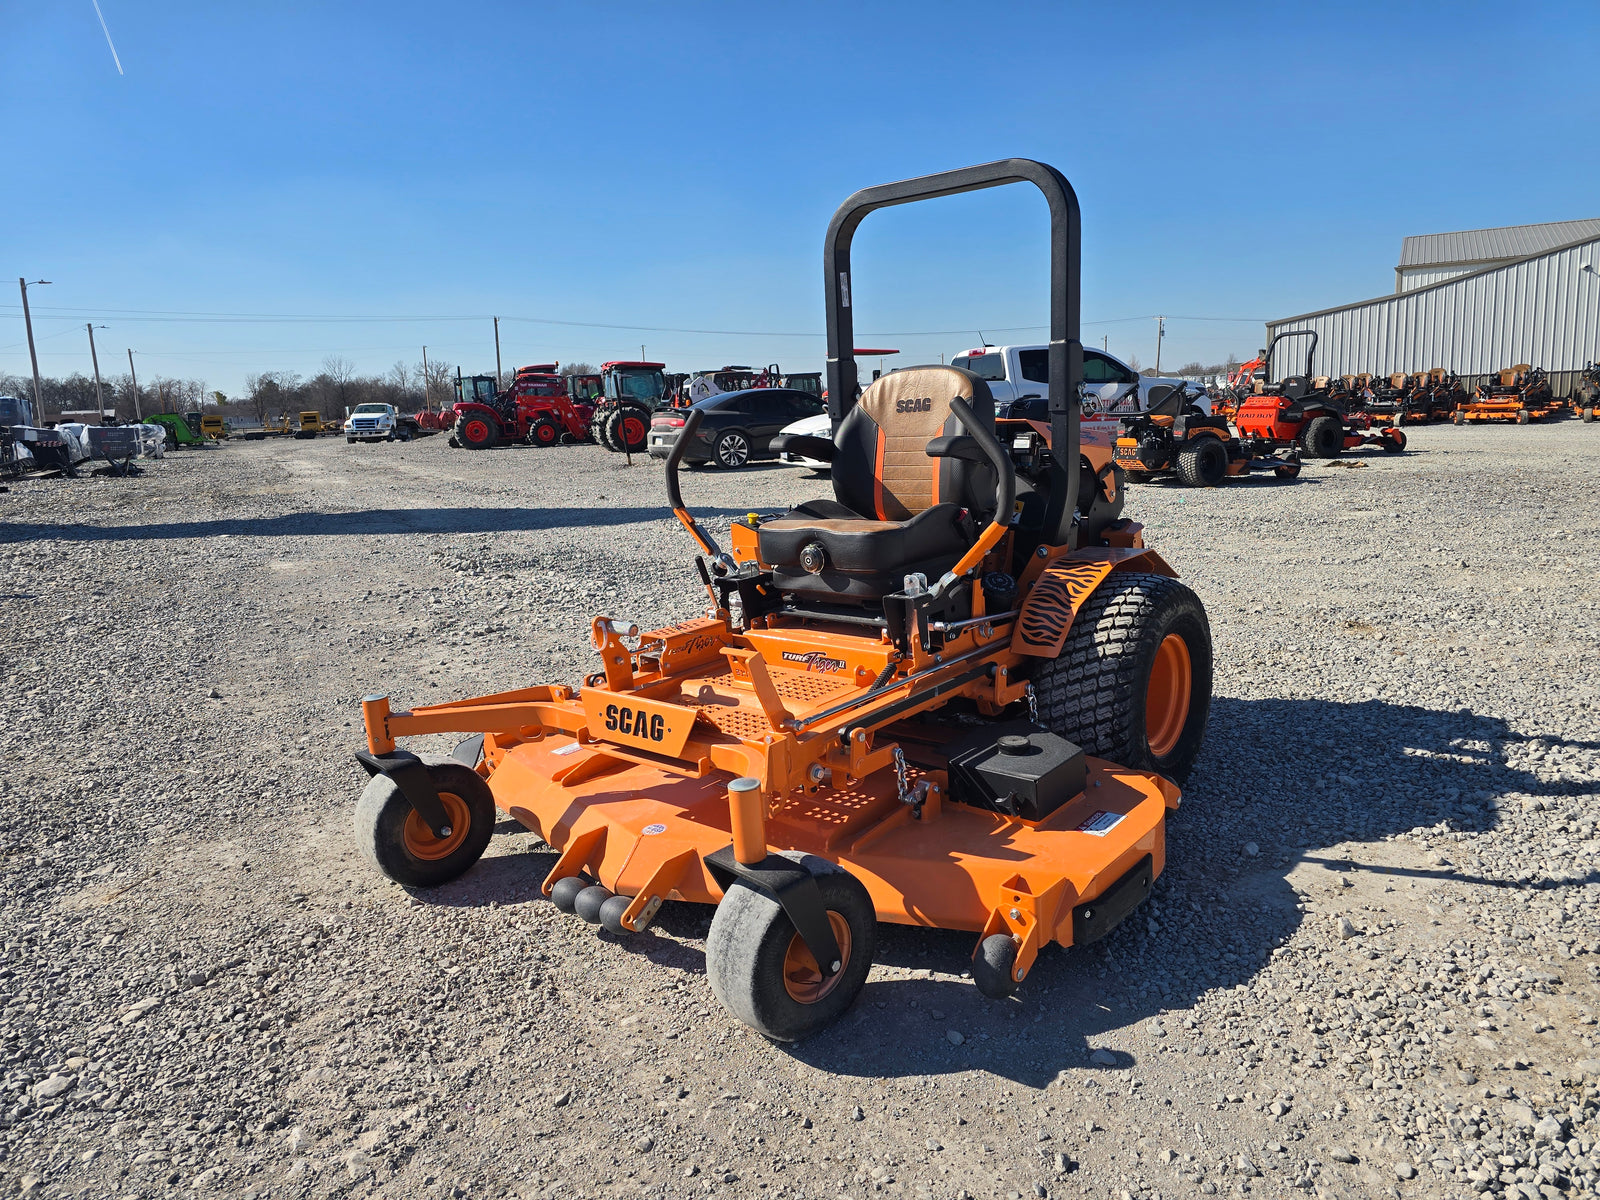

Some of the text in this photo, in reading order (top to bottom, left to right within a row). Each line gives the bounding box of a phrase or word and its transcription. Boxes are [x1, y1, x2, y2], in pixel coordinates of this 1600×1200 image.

[896, 397, 931, 413] SCAG
[1120, 448, 1136, 456] SCAG
[783, 652, 809, 662] TURF
[803, 651, 838, 674] Tiger
[605, 704, 664, 742] SCAG
